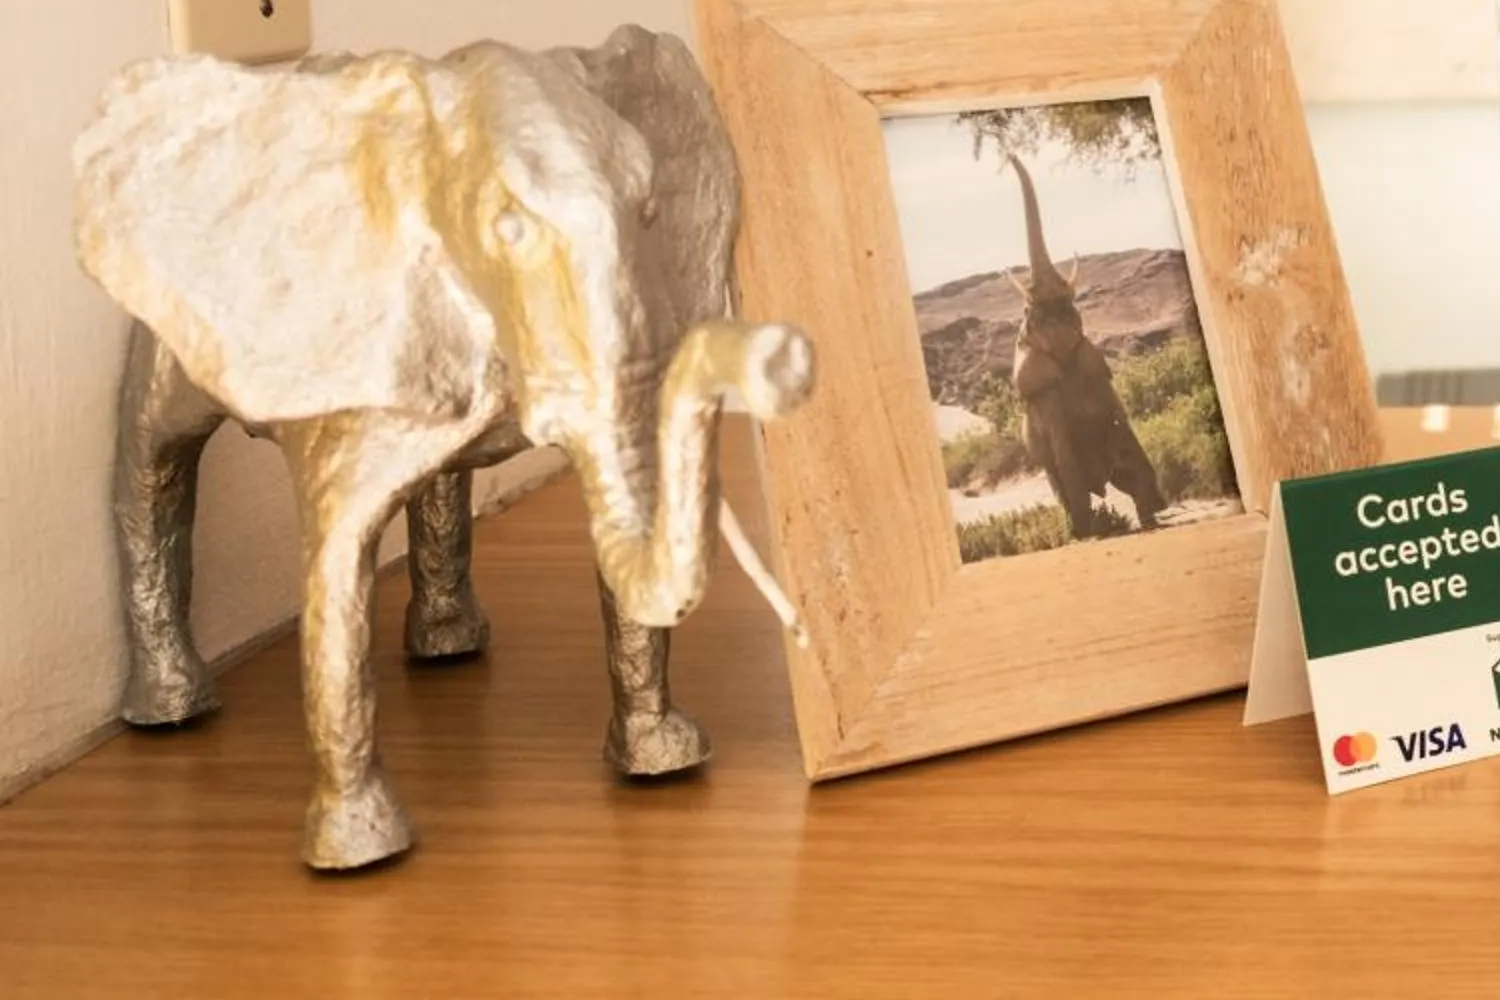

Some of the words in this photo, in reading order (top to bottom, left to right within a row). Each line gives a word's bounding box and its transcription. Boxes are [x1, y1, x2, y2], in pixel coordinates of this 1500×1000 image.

[1356, 482, 1469, 529] Cards
[1386, 572, 1468, 611] here
[1389, 722, 1467, 762] VISA
